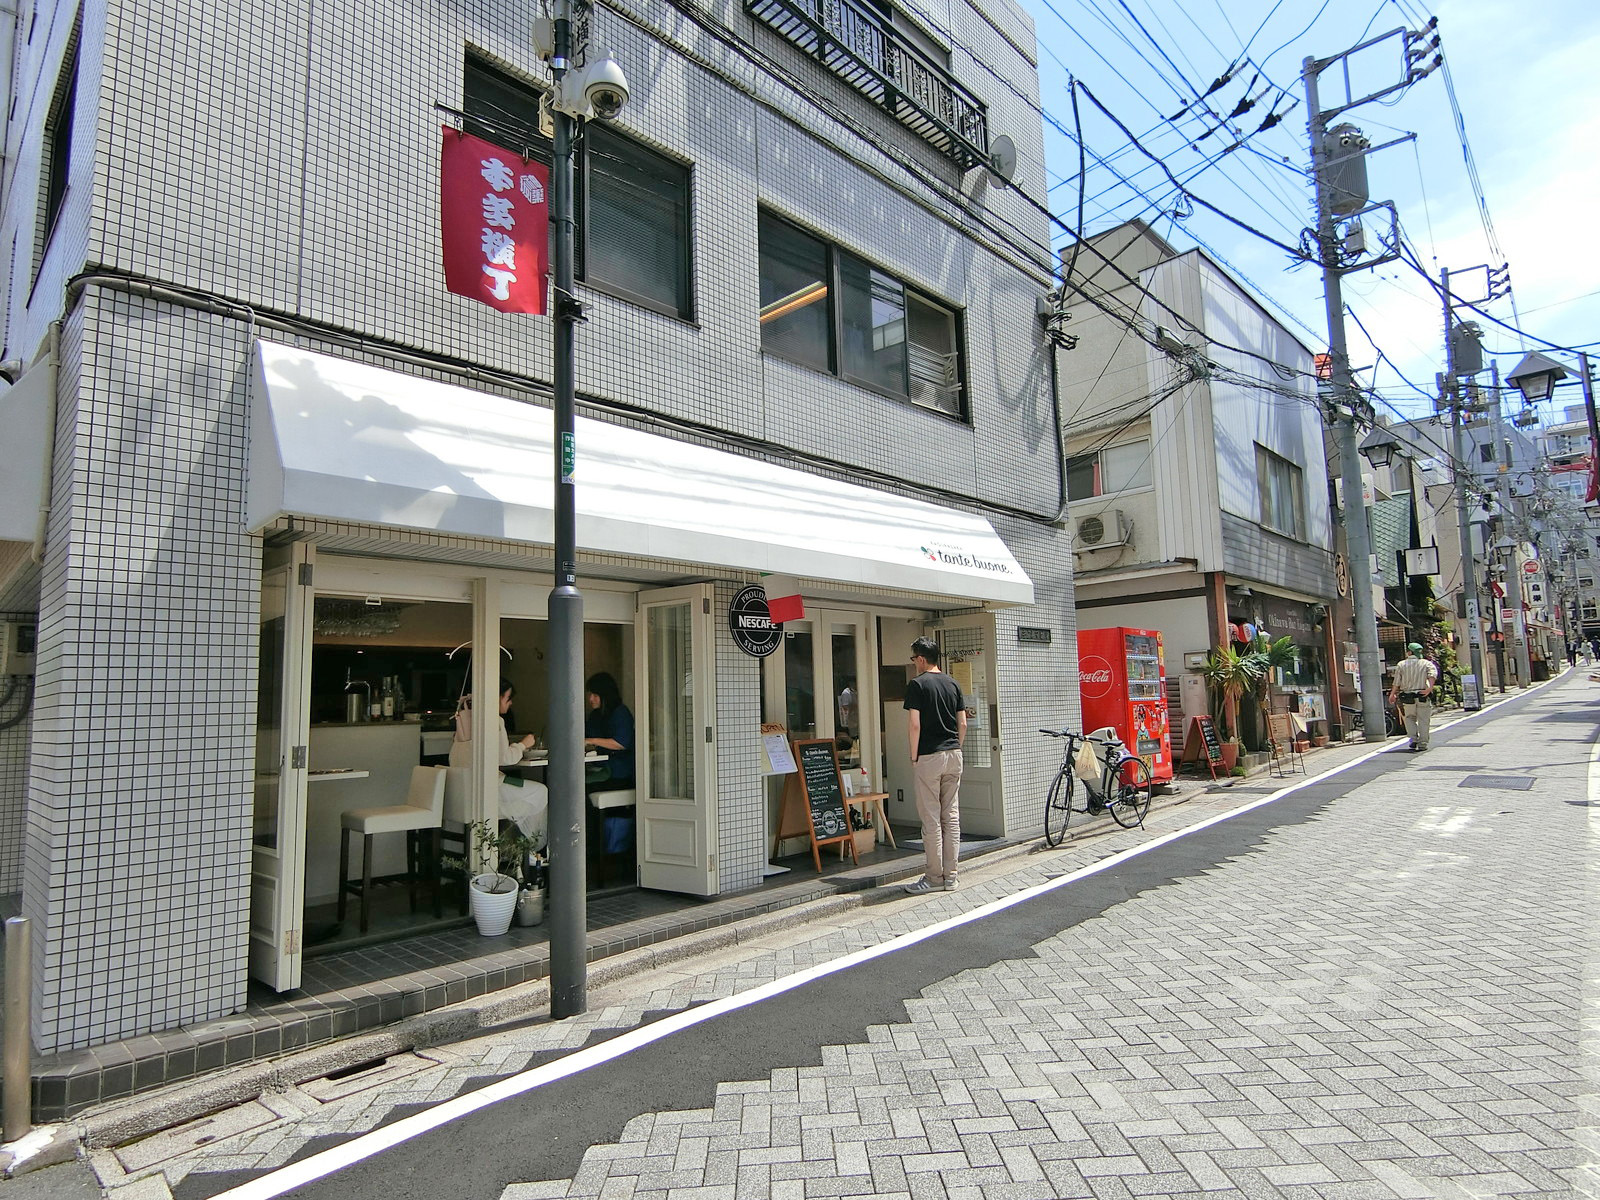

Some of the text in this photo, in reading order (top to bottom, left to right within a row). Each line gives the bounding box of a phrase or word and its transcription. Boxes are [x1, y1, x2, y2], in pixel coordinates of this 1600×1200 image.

[480, 157, 517, 302] 本多横丁
[937, 549, 973, 568] tante
[740, 590, 767, 603] PROUD
[743, 639, 775, 653] SERVING
